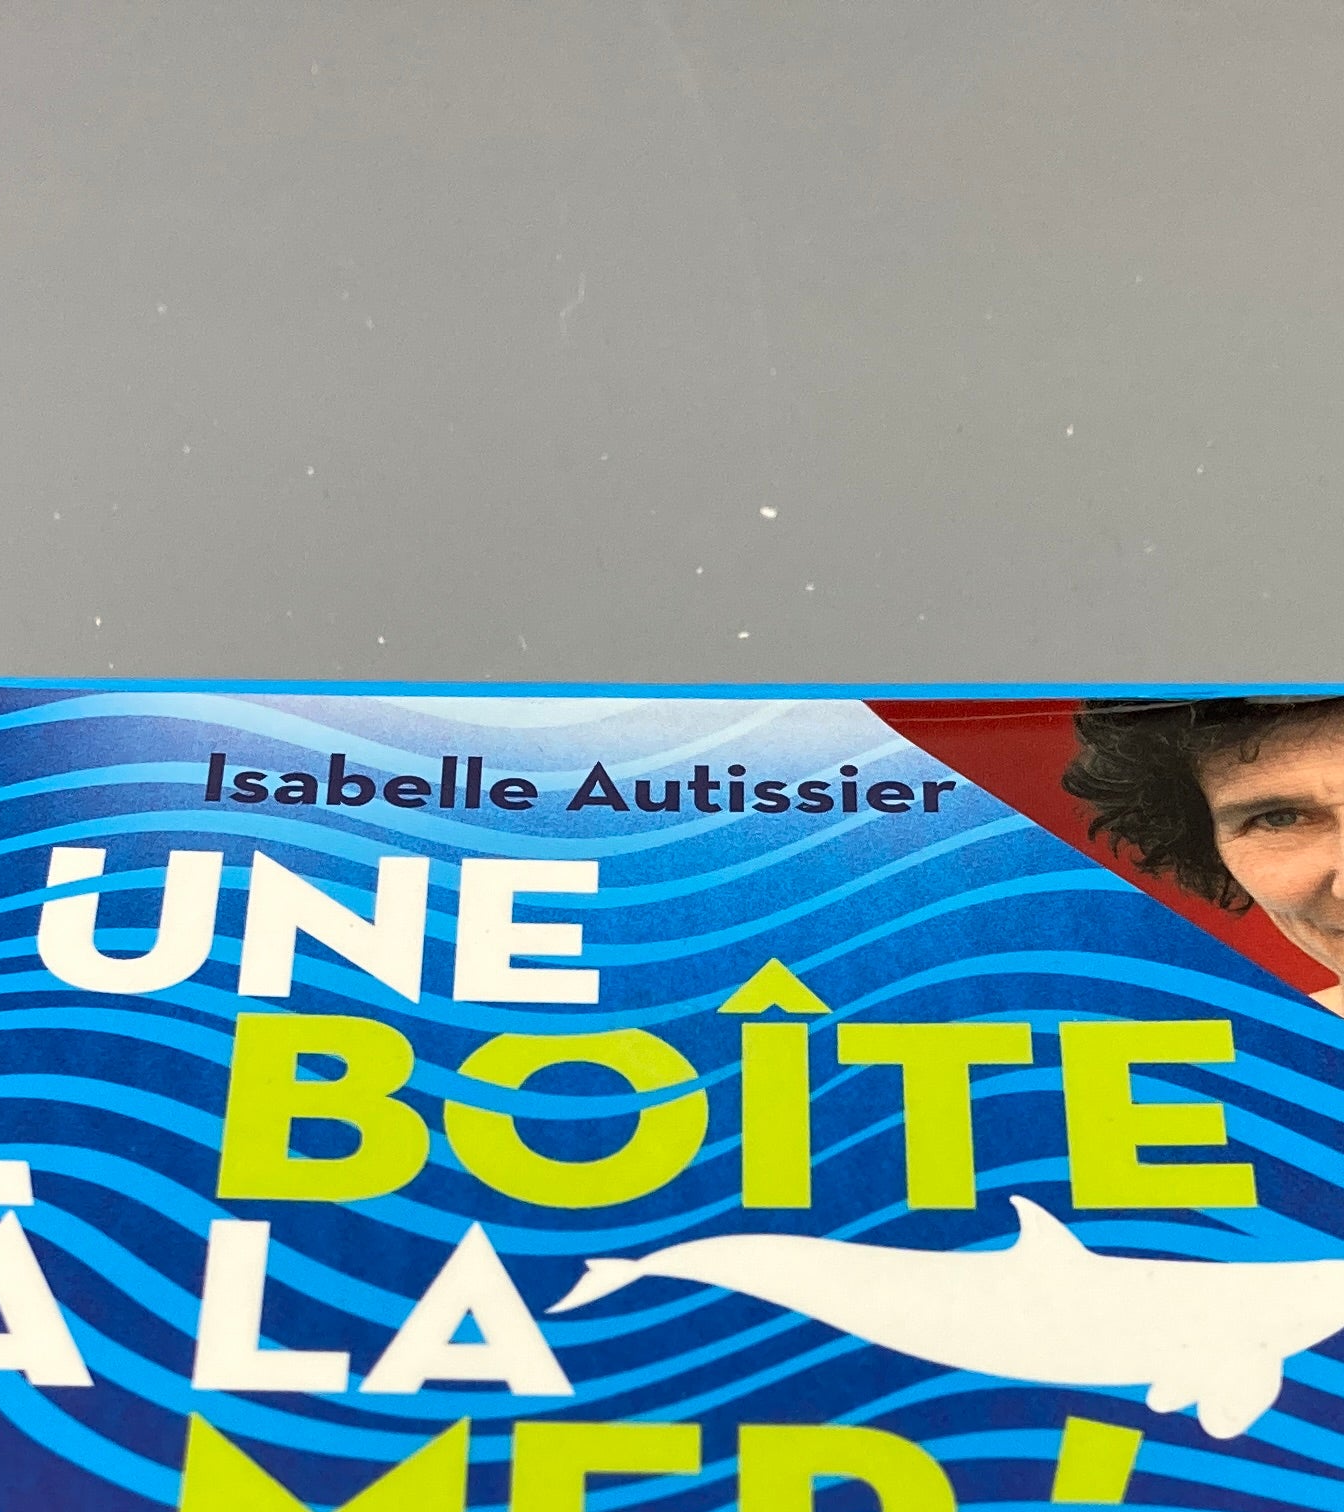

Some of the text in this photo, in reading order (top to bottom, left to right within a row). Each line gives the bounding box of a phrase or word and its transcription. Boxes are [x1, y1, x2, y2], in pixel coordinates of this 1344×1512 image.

[204, 752, 958, 814] Isabelle Autissier
[36, 845, 602, 1004] UNE
[217, 957, 1261, 1211] BOÎTE
[191, 1218, 576, 1397] LA
